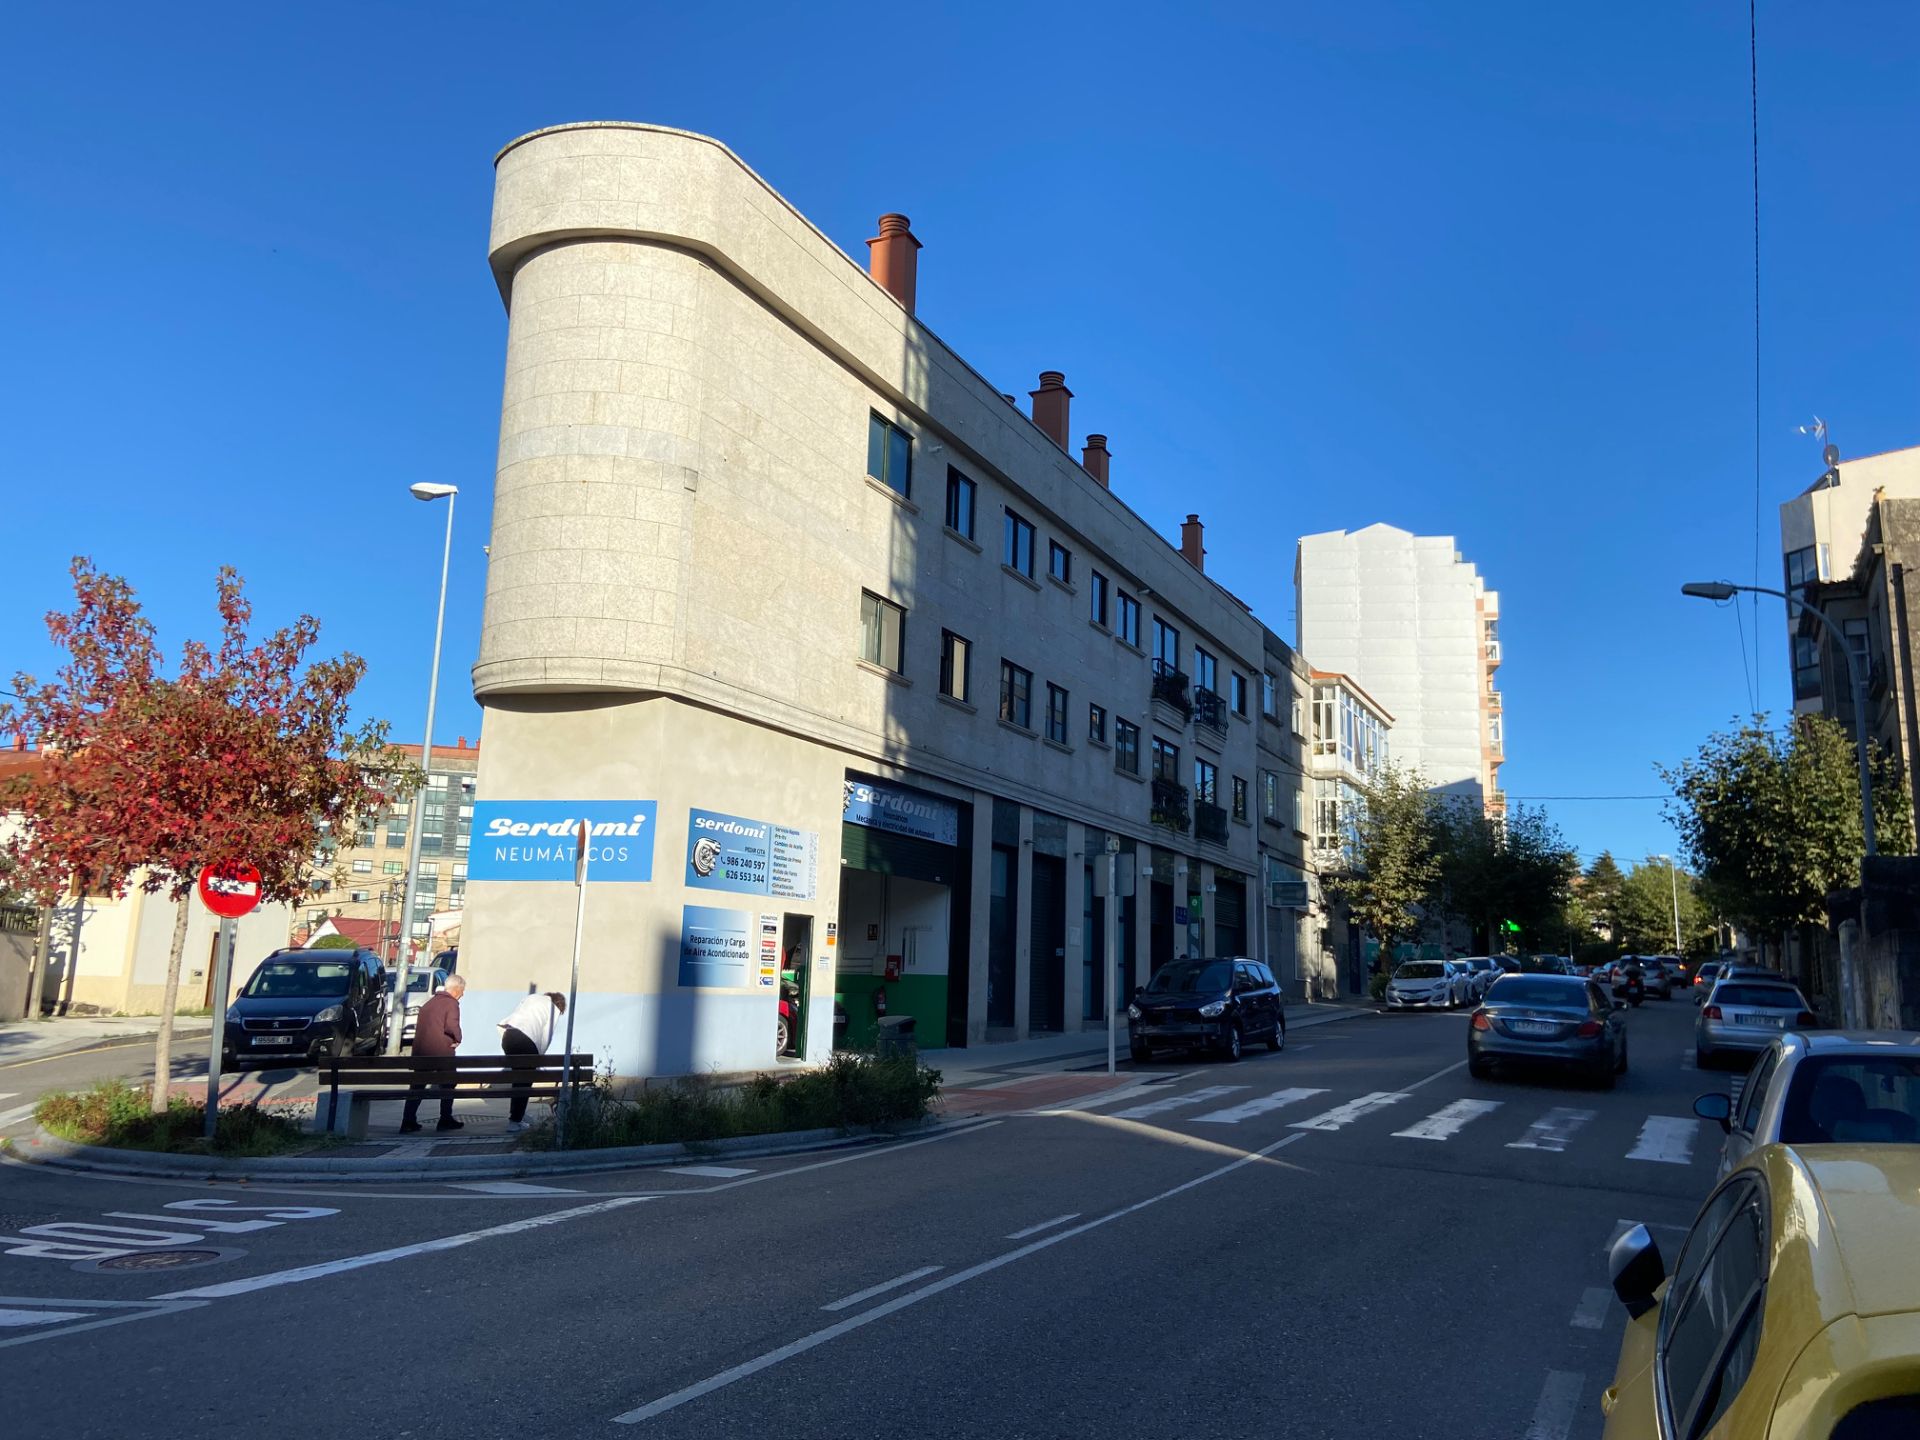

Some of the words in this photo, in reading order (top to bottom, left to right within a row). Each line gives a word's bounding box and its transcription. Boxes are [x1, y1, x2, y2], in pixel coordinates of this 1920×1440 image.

[496, 844, 628, 862] NEUMÁTCOS
[727, 856, 739, 866] 986
[740, 858, 752, 868] 240
[754, 861, 765, 870] 597
[726, 870, 738, 880] 626
[740, 872, 751, 881] 553
[753, 874, 764, 883] 344
[690, 934, 723, 946] Reparación
[724, 939, 728, 947] y
[729, 938, 745, 948] Carga
[693, 948, 706, 956] Aire
[707, 949, 749, 959] Acondicionado
